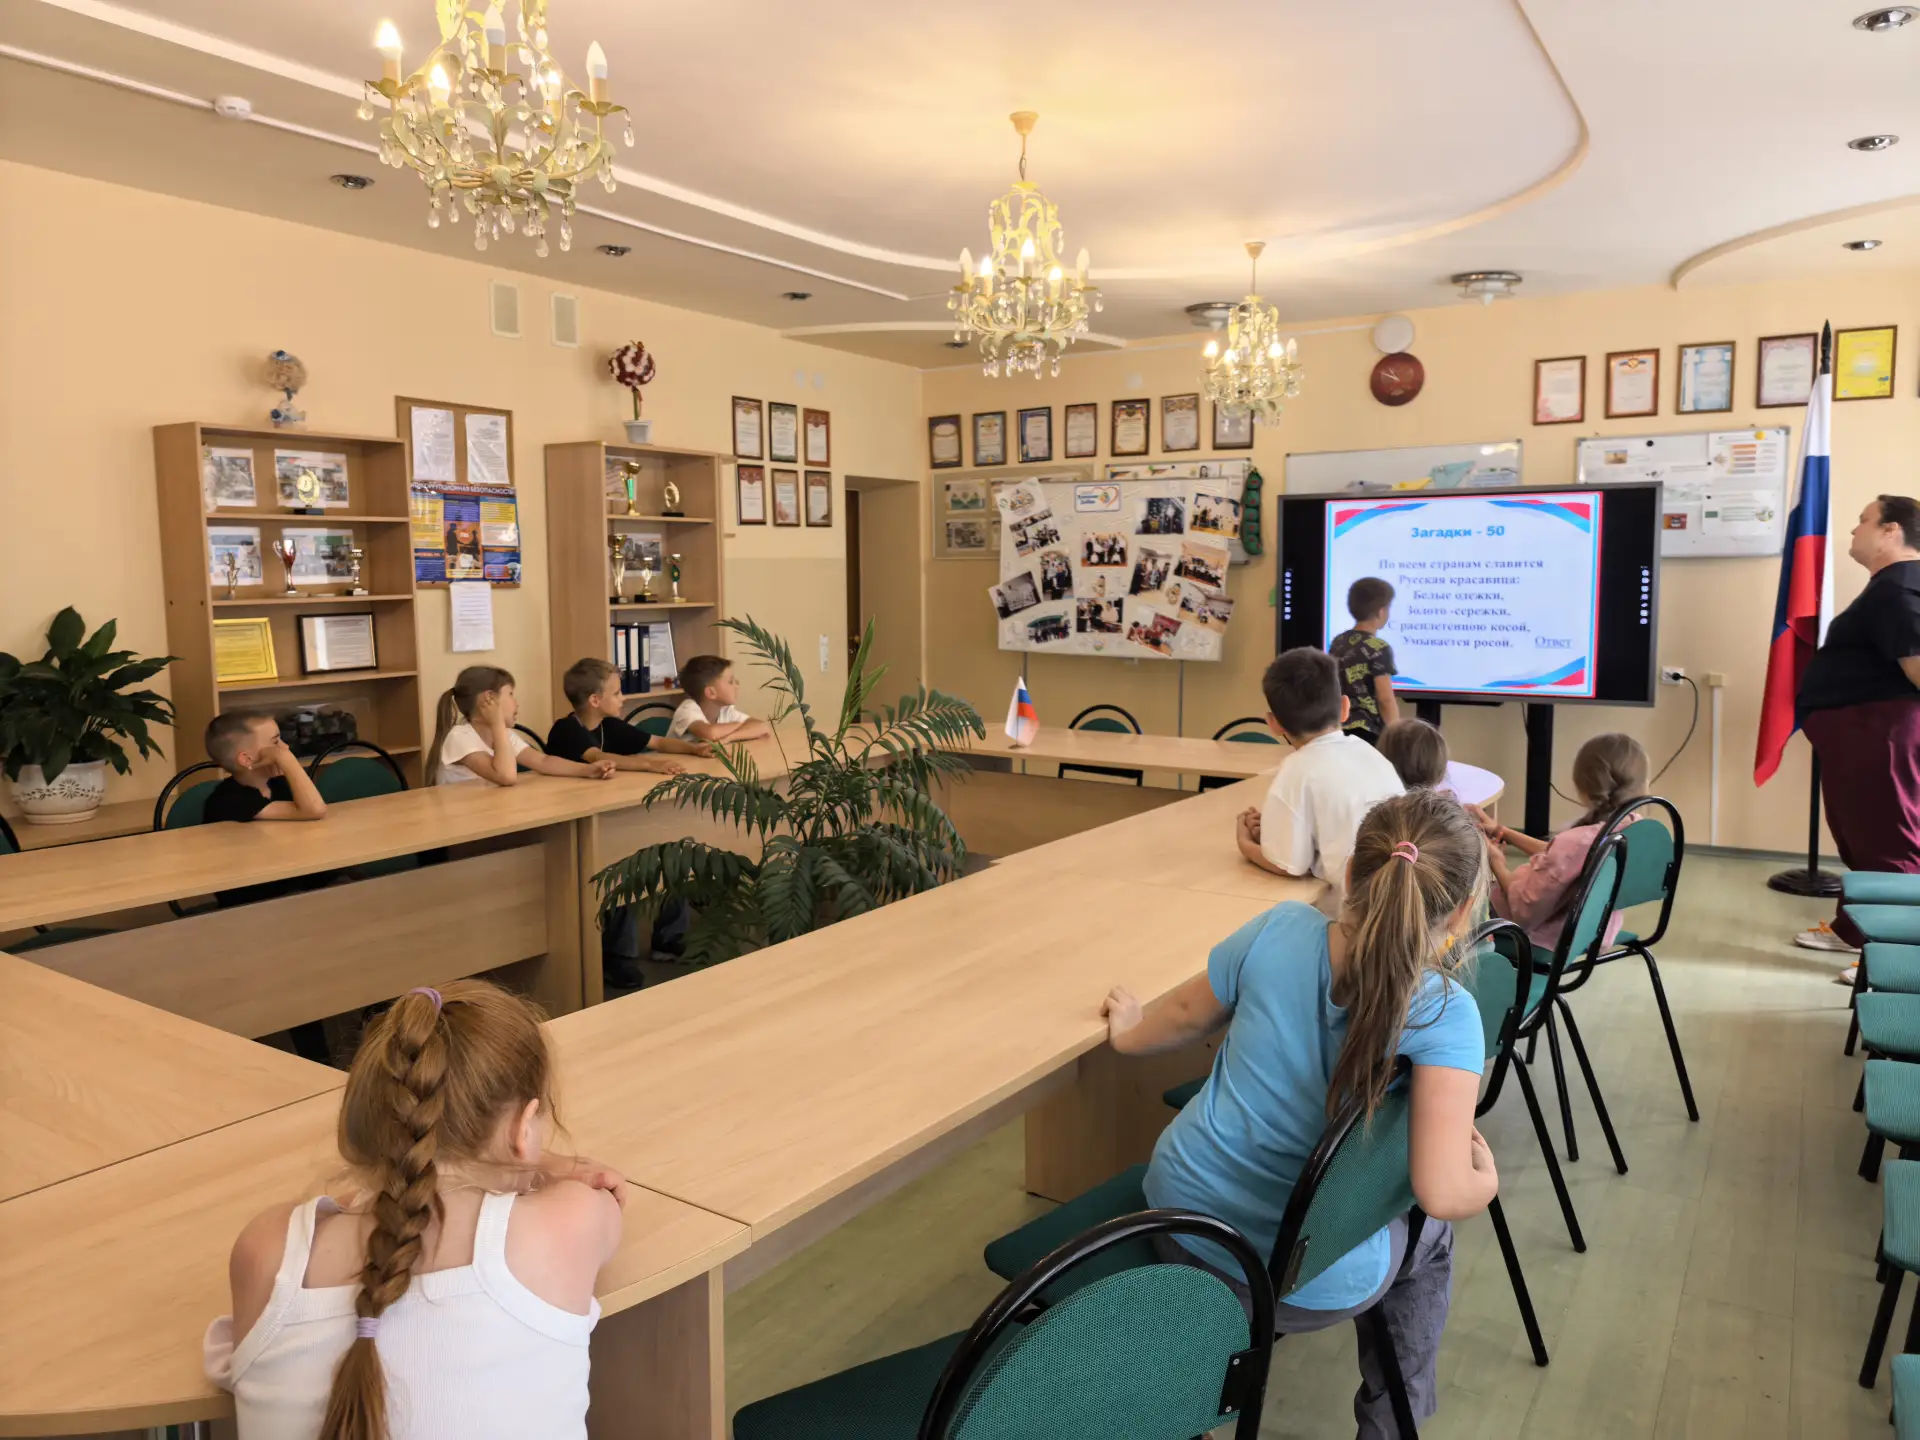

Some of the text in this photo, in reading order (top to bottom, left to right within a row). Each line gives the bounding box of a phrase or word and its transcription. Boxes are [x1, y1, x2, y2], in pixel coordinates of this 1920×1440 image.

[1411, 527, 1472, 539] Загадки
[1487, 525, 1505, 537] 50
[1379, 559, 1544, 571] По всем странам славится
[1399, 575, 1520, 587] Русская красавица:
[1413, 590, 1451, 600] Белые
[1408, 605, 1447, 616] Золото
[1403, 636, 1470, 646] Умывается
[1534, 635, 1572, 648] Ответ
